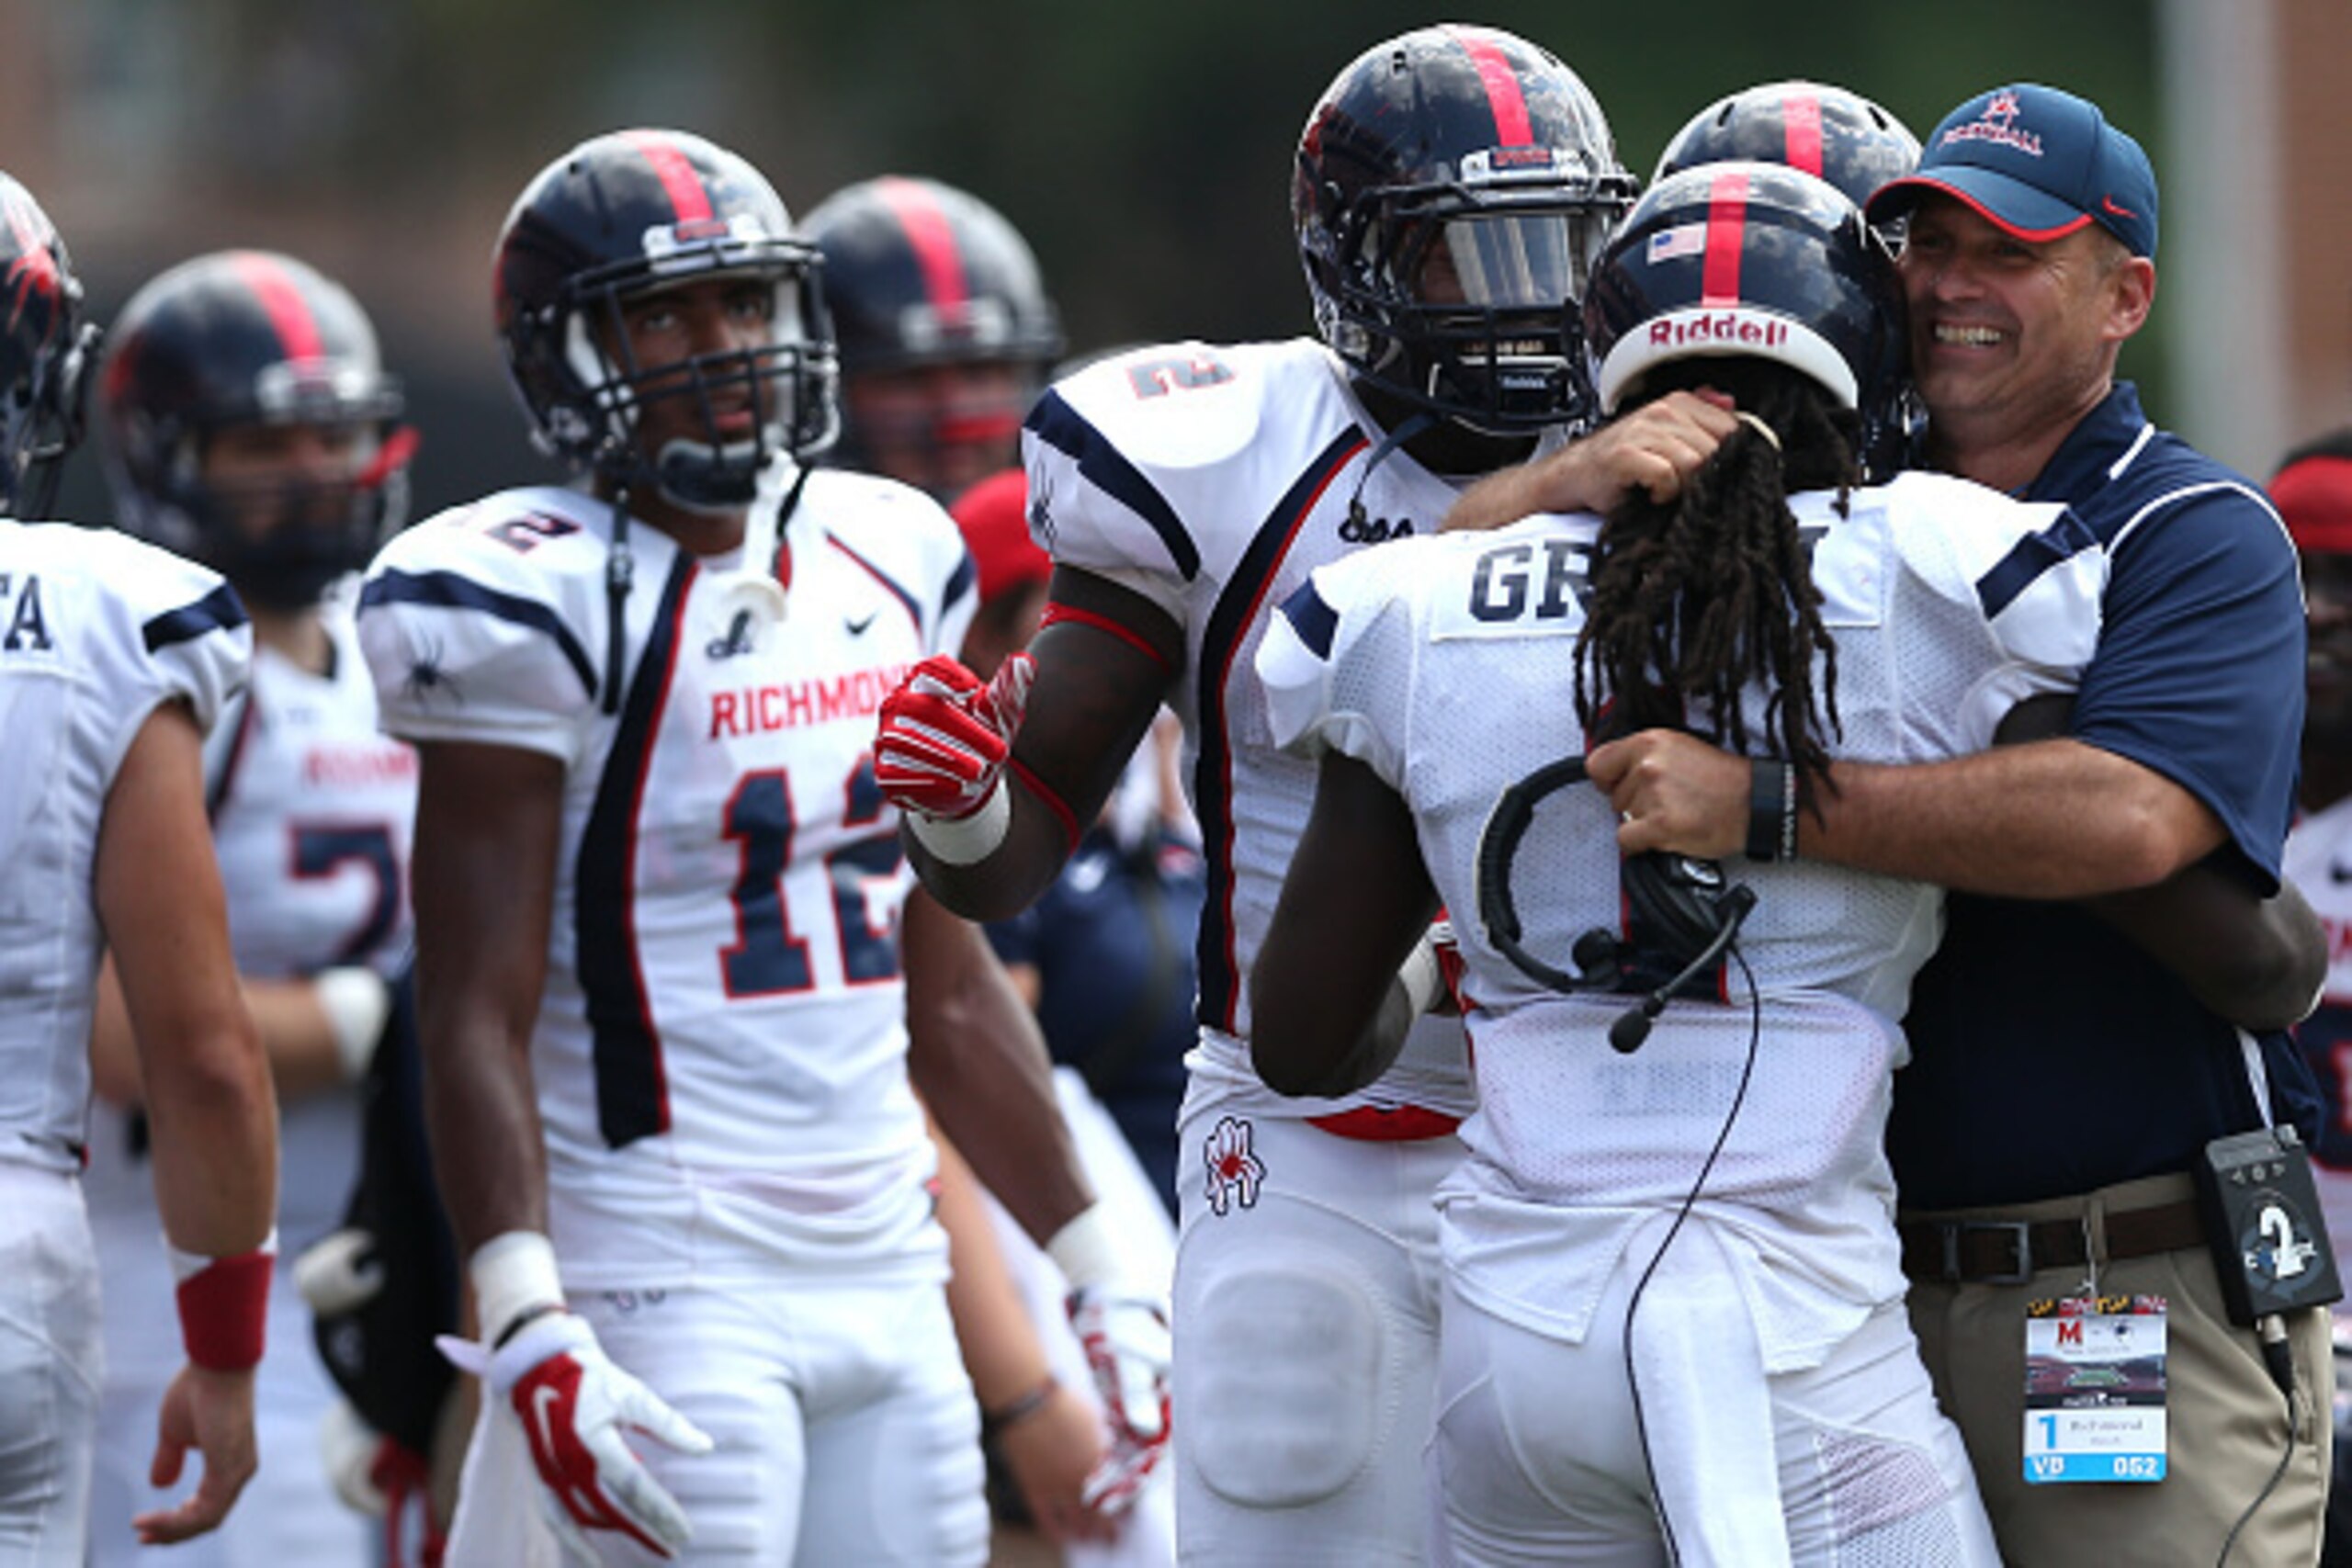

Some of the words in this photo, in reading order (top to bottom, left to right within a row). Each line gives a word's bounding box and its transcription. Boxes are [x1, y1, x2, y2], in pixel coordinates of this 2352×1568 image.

[718, 750, 903, 1001] 12
[2260, 1206, 2305, 1279] 2
[2057, 1320, 2084, 1345] M
[2038, 1413, 2057, 1450] 1
